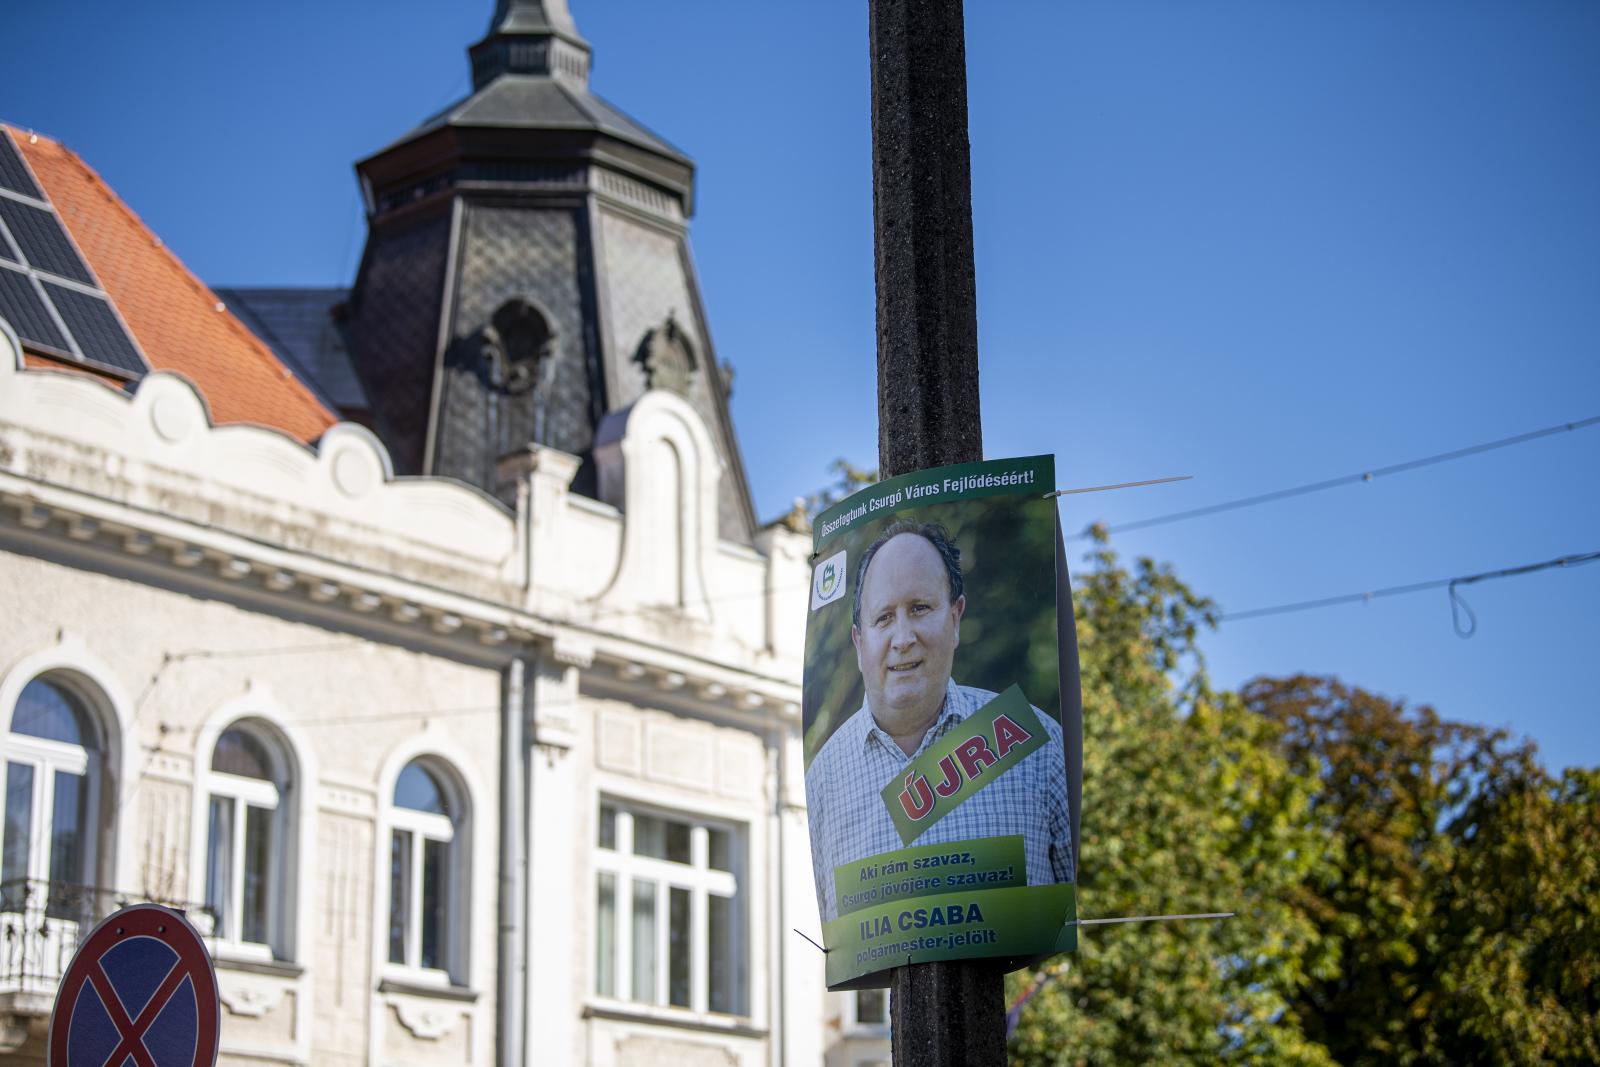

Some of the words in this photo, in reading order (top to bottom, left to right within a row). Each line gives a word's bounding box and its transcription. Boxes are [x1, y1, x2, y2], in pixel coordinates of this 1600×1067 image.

[821, 502, 868, 537] Összefogtunk
[869, 488, 902, 511] Csurgó
[905, 483, 940, 500] Város
[943, 469, 1034, 496] Fejlődéséért!
[897, 713, 1033, 822] ÚJRA
[842, 886, 878, 907] Csurgó
[880, 875, 941, 898] jövőjére
[946, 866, 1014, 886] szavaz!
[859, 863, 878, 882] Aki
[881, 860, 909, 876] rám
[913, 852, 976, 870] szavaz,
[860, 915, 893, 941] ILIA
[898, 903, 985, 932] CSABA
[856, 929, 997, 966] polgármester-jelölt
